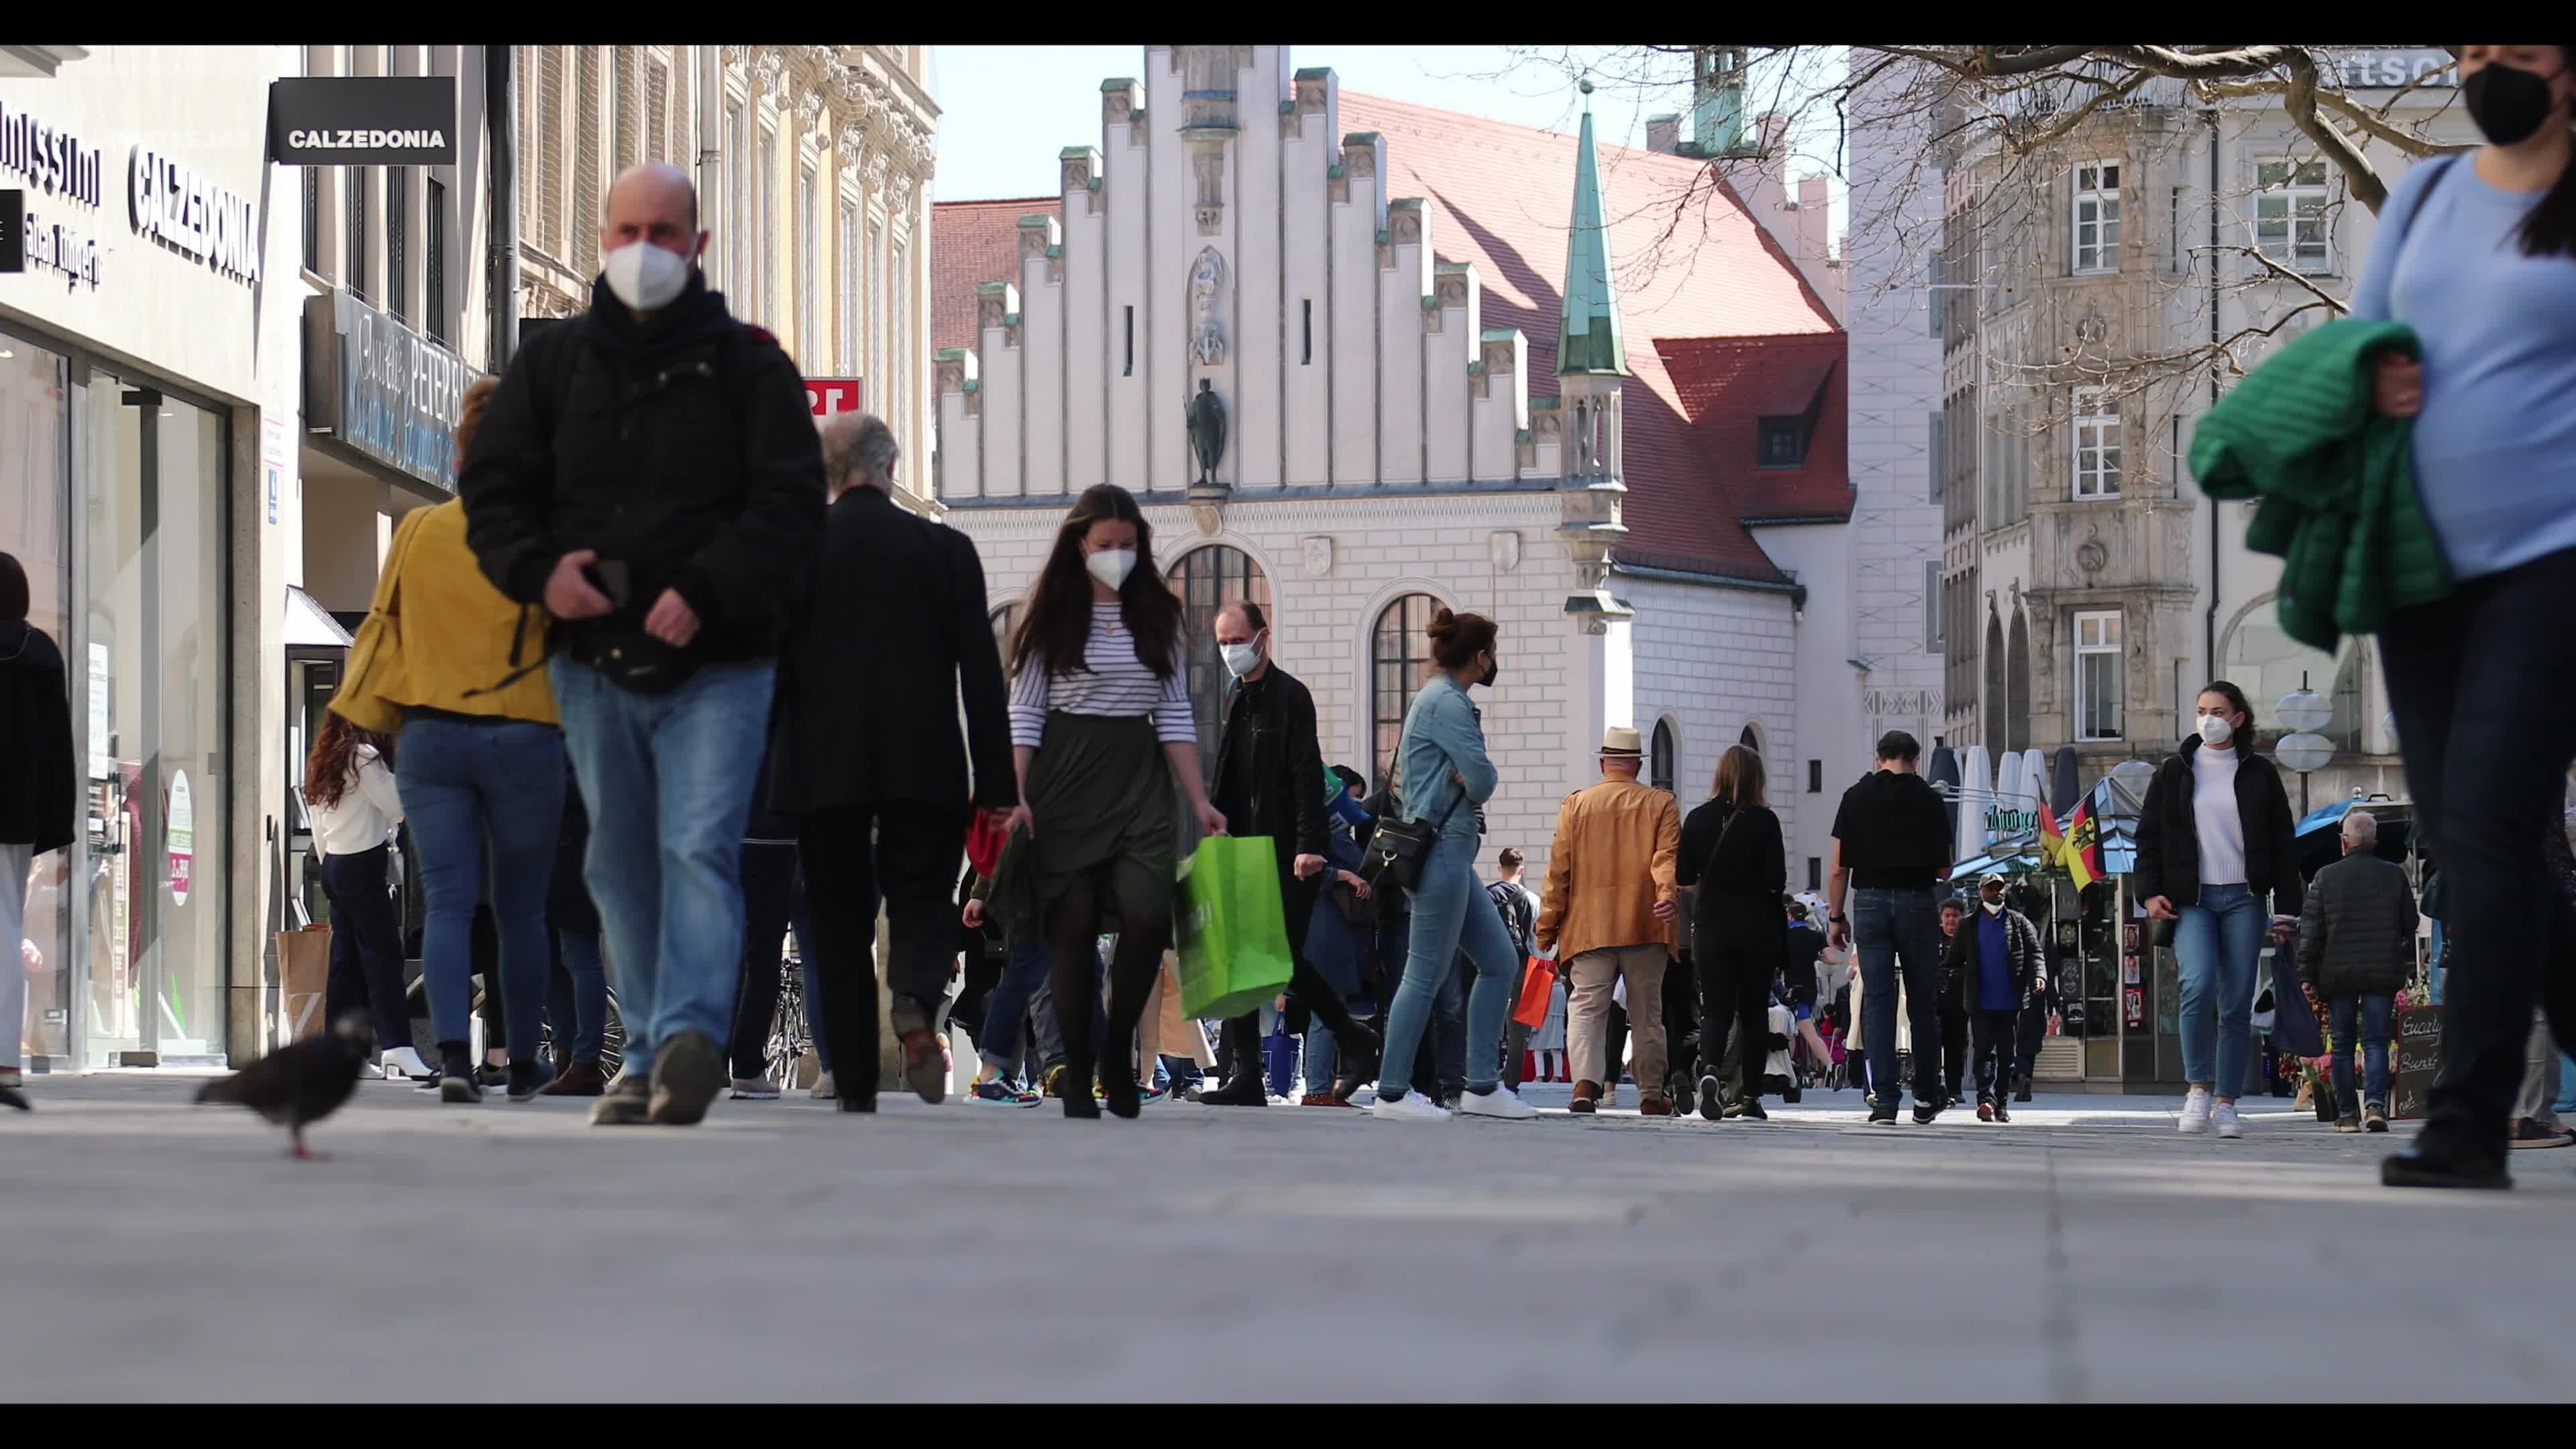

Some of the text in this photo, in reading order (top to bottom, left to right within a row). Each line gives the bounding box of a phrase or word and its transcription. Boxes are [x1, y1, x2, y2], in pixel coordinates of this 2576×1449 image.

[288, 129, 446, 149] CALZEDONIA
[128, 143, 260, 284] CALZEDONIA
[2402, 1014, 2443, 1046] Eucaly
